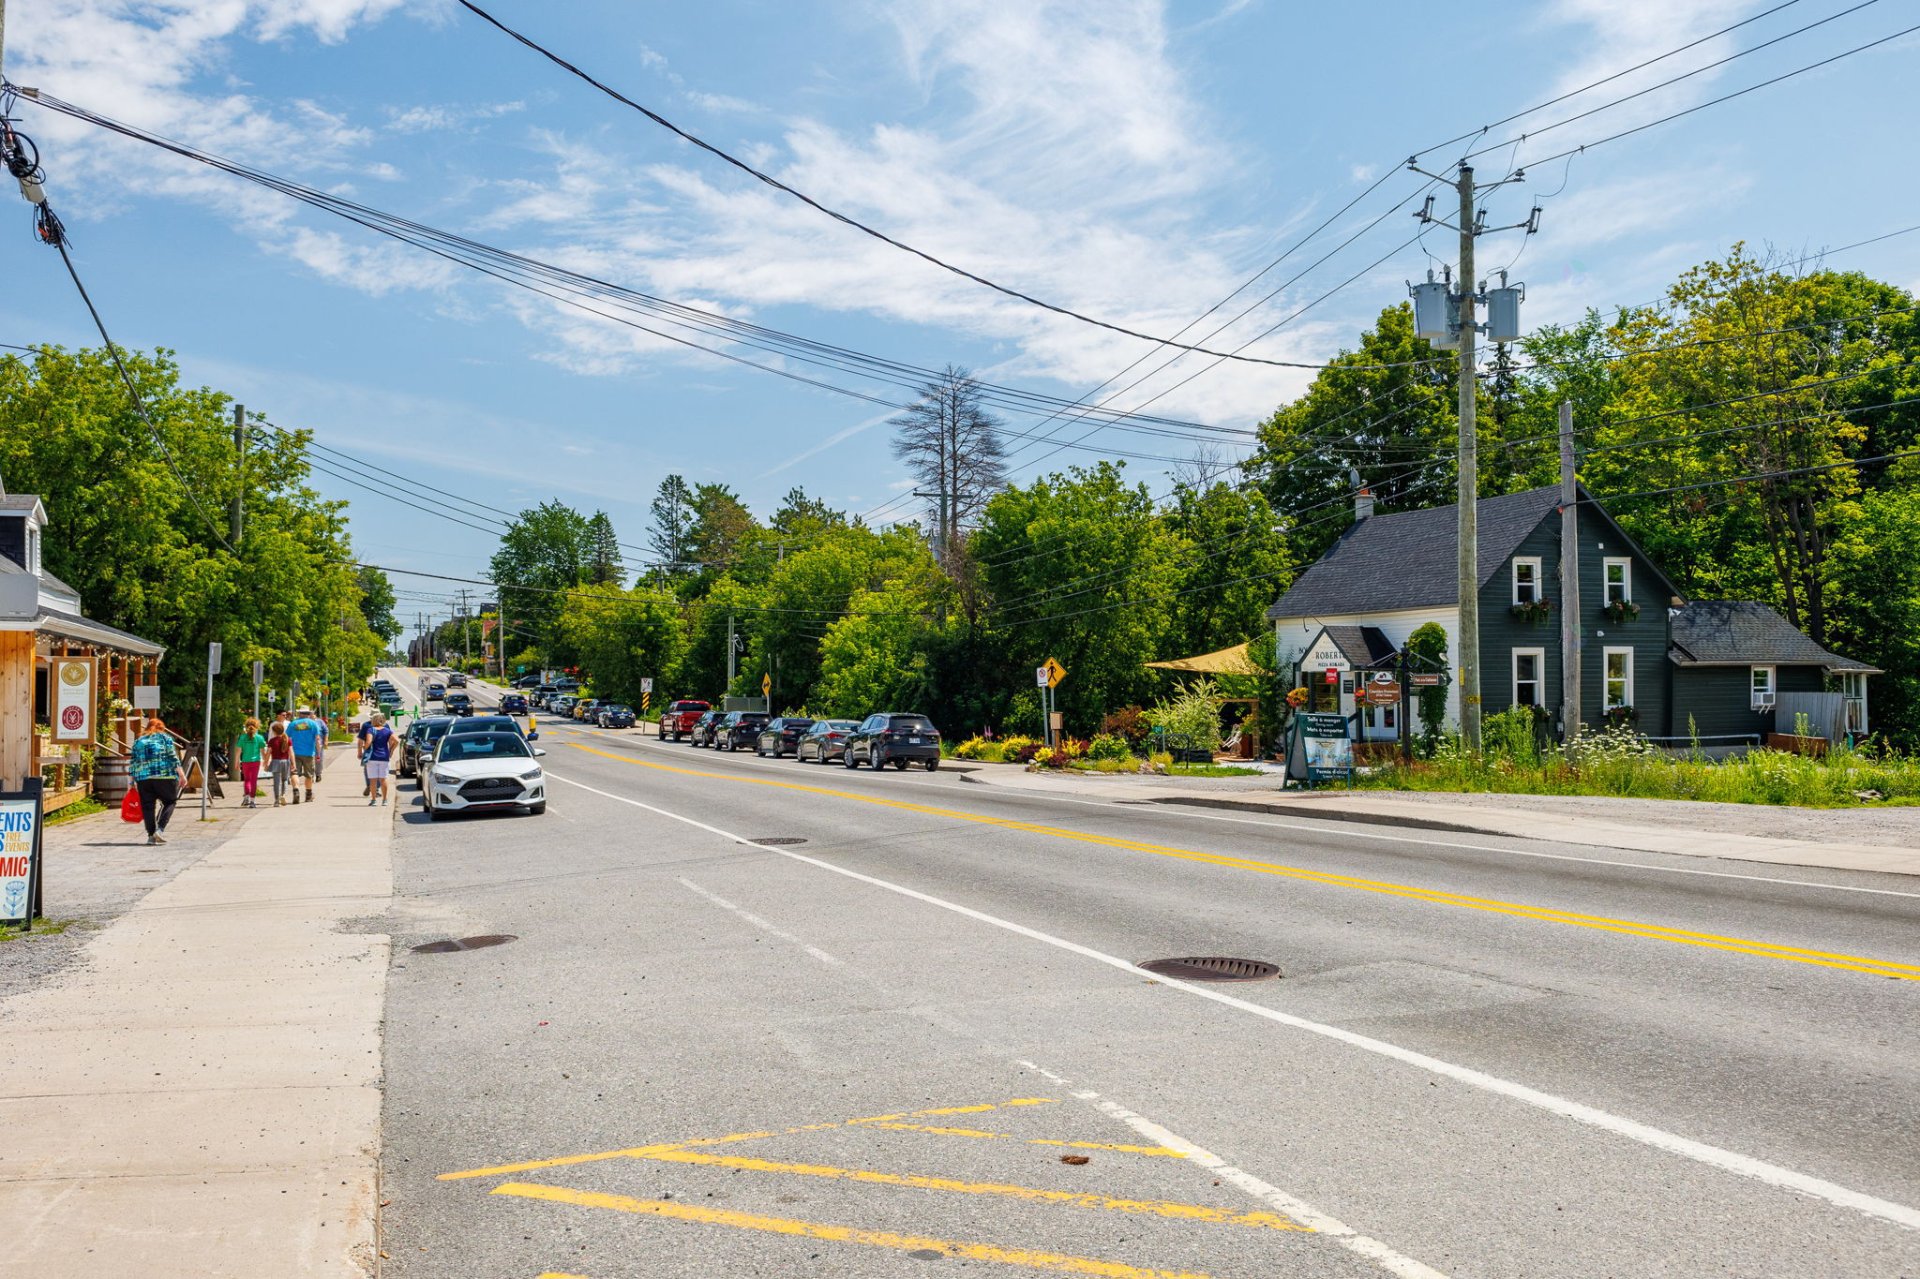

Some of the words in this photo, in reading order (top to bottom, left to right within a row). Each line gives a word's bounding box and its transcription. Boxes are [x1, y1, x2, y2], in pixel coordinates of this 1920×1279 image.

[1315, 651, 1344, 660] ROBERT
[6, 832, 21, 841] FREE
[5, 842, 30, 853] EVENTS
